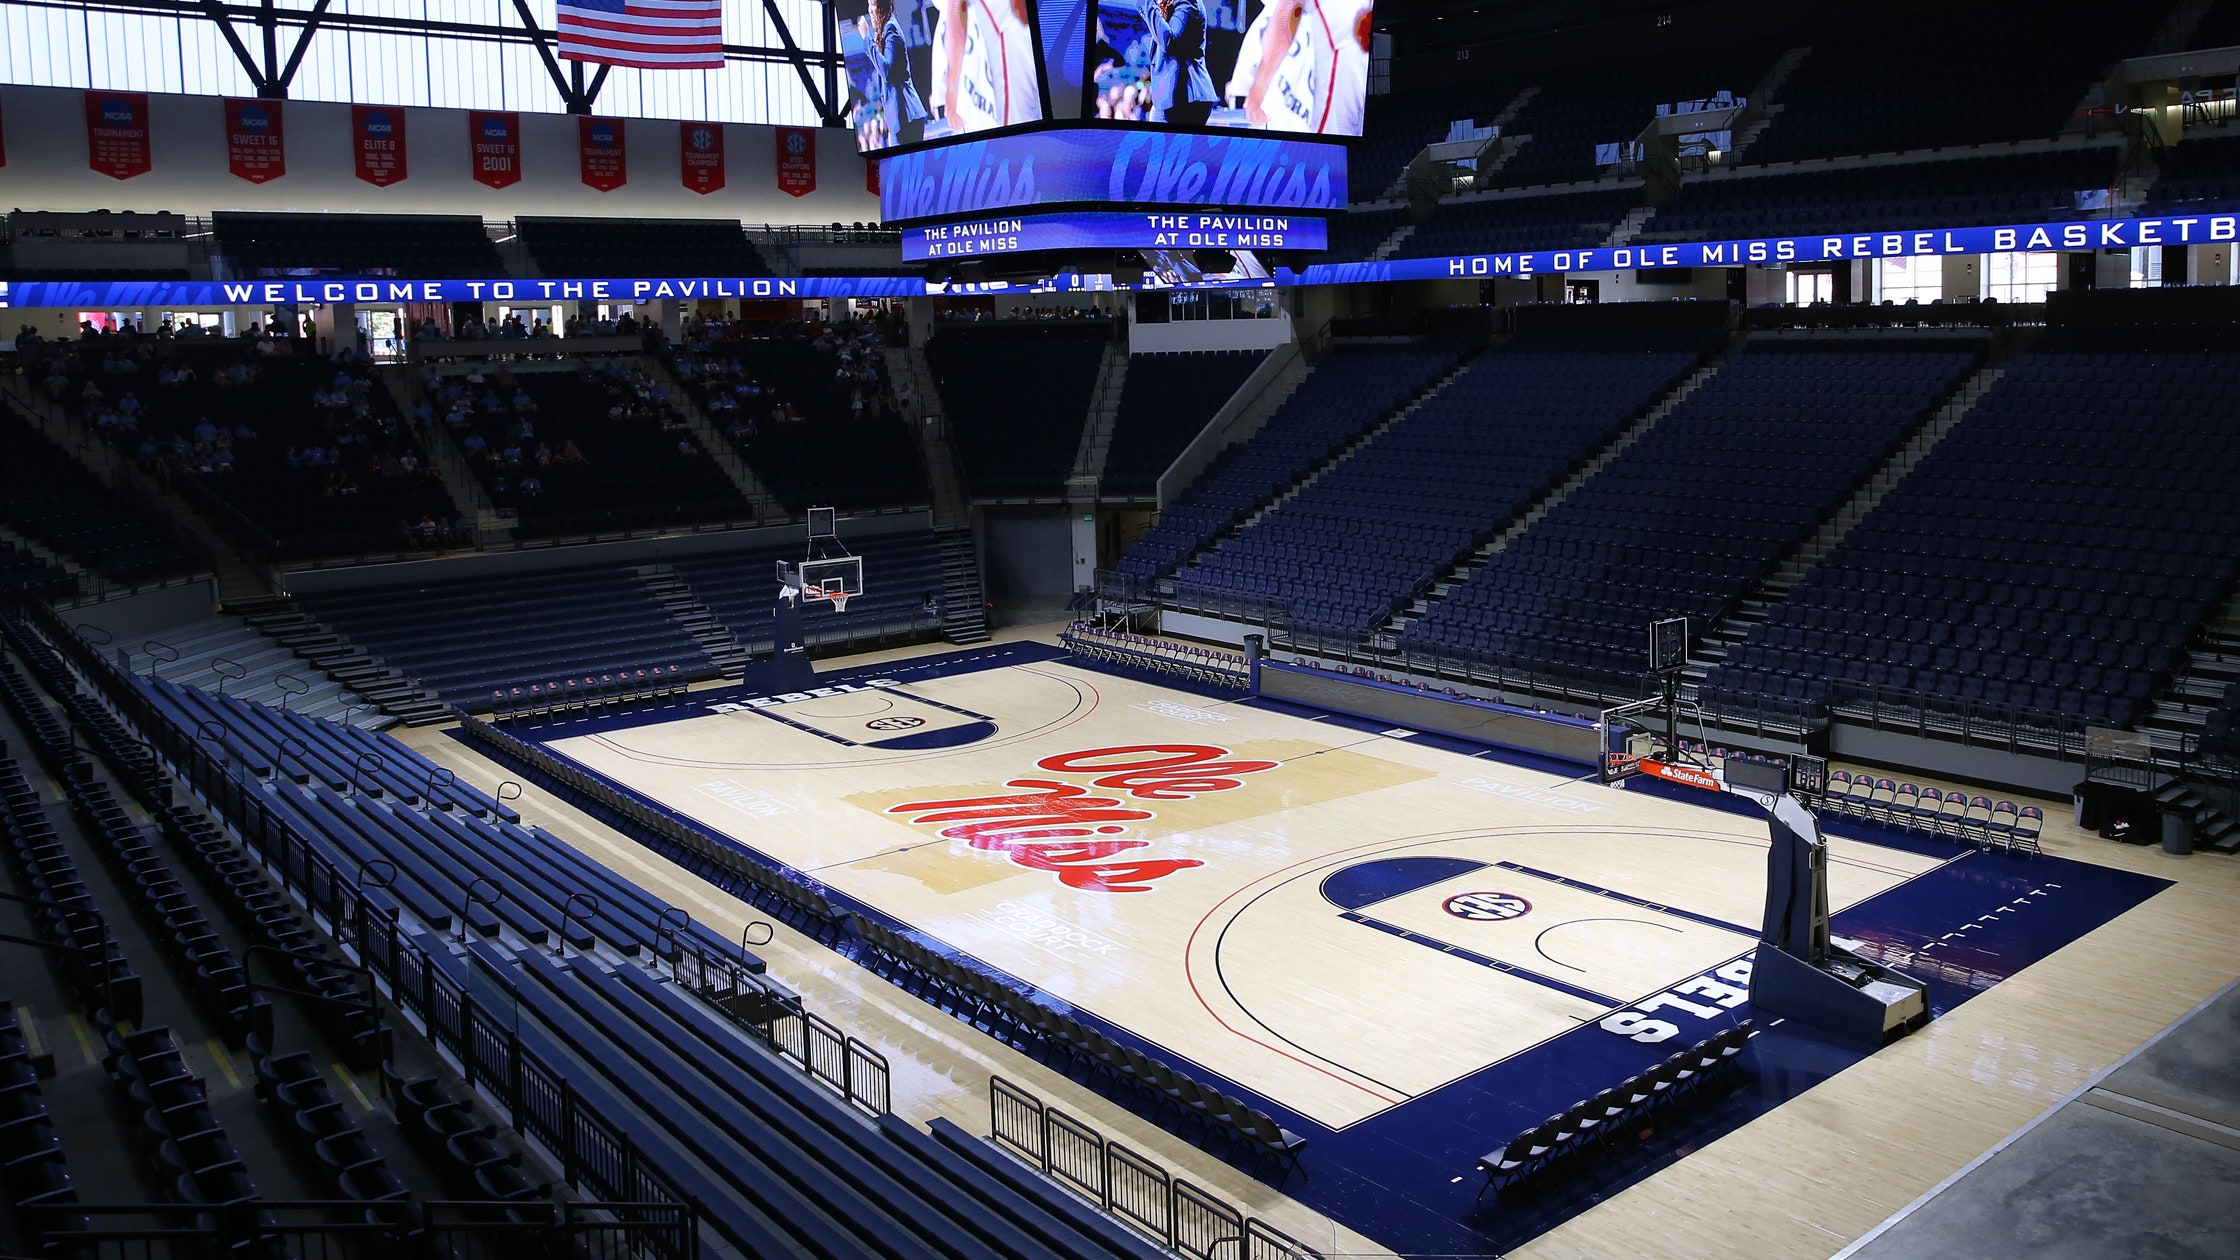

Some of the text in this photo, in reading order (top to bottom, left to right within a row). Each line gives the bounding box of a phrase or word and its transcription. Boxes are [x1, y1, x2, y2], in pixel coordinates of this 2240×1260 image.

[103, 111, 133, 121] NCAA
[241, 118, 268, 127] NCAA
[93, 128, 145, 138] TOURNAMENT
[367, 124, 392, 132] NCAA
[484, 129, 508, 137] NCAA
[233, 134, 278, 146] SWEET 16
[364, 140, 396, 151] ELITE 8
[476, 144, 516, 154] SWEET 16
[692, 128, 713, 150] SEC
[786, 133, 806, 154] SEC
[483, 157, 512, 171] 2001
[1208, 136, 1337, 209] Miss
[933, 141, 1041, 216] Miss
[924, 219, 1022, 241] THE PAVILION
[1147, 216, 1288, 231] THE PAVILION
[928, 236, 1018, 256] AT OLE MISS
[1154, 233, 1284, 247] AT OLE MISS
[1450, 216, 2237, 276] HOME OF OLE MISS REBEL BASKETB
[223, 280, 797, 302] WELCOME TO THE PAVILION
[705, 679, 902, 714] REBELS
[1147, 700, 1233, 722] CRADDOCK
[1148, 706, 1209, 721] COURT
[868, 717, 921, 730] SEC
[1034, 743, 1284, 800] Ole
[700, 781, 788, 817] PAVILION
[1460, 778, 1601, 813] PAVILION
[883, 779, 1211, 895] Miss
[1449, 894, 1526, 920] SEC
[994, 916, 1080, 951] COURT
[995, 902, 1122, 956] CRADDOCK
